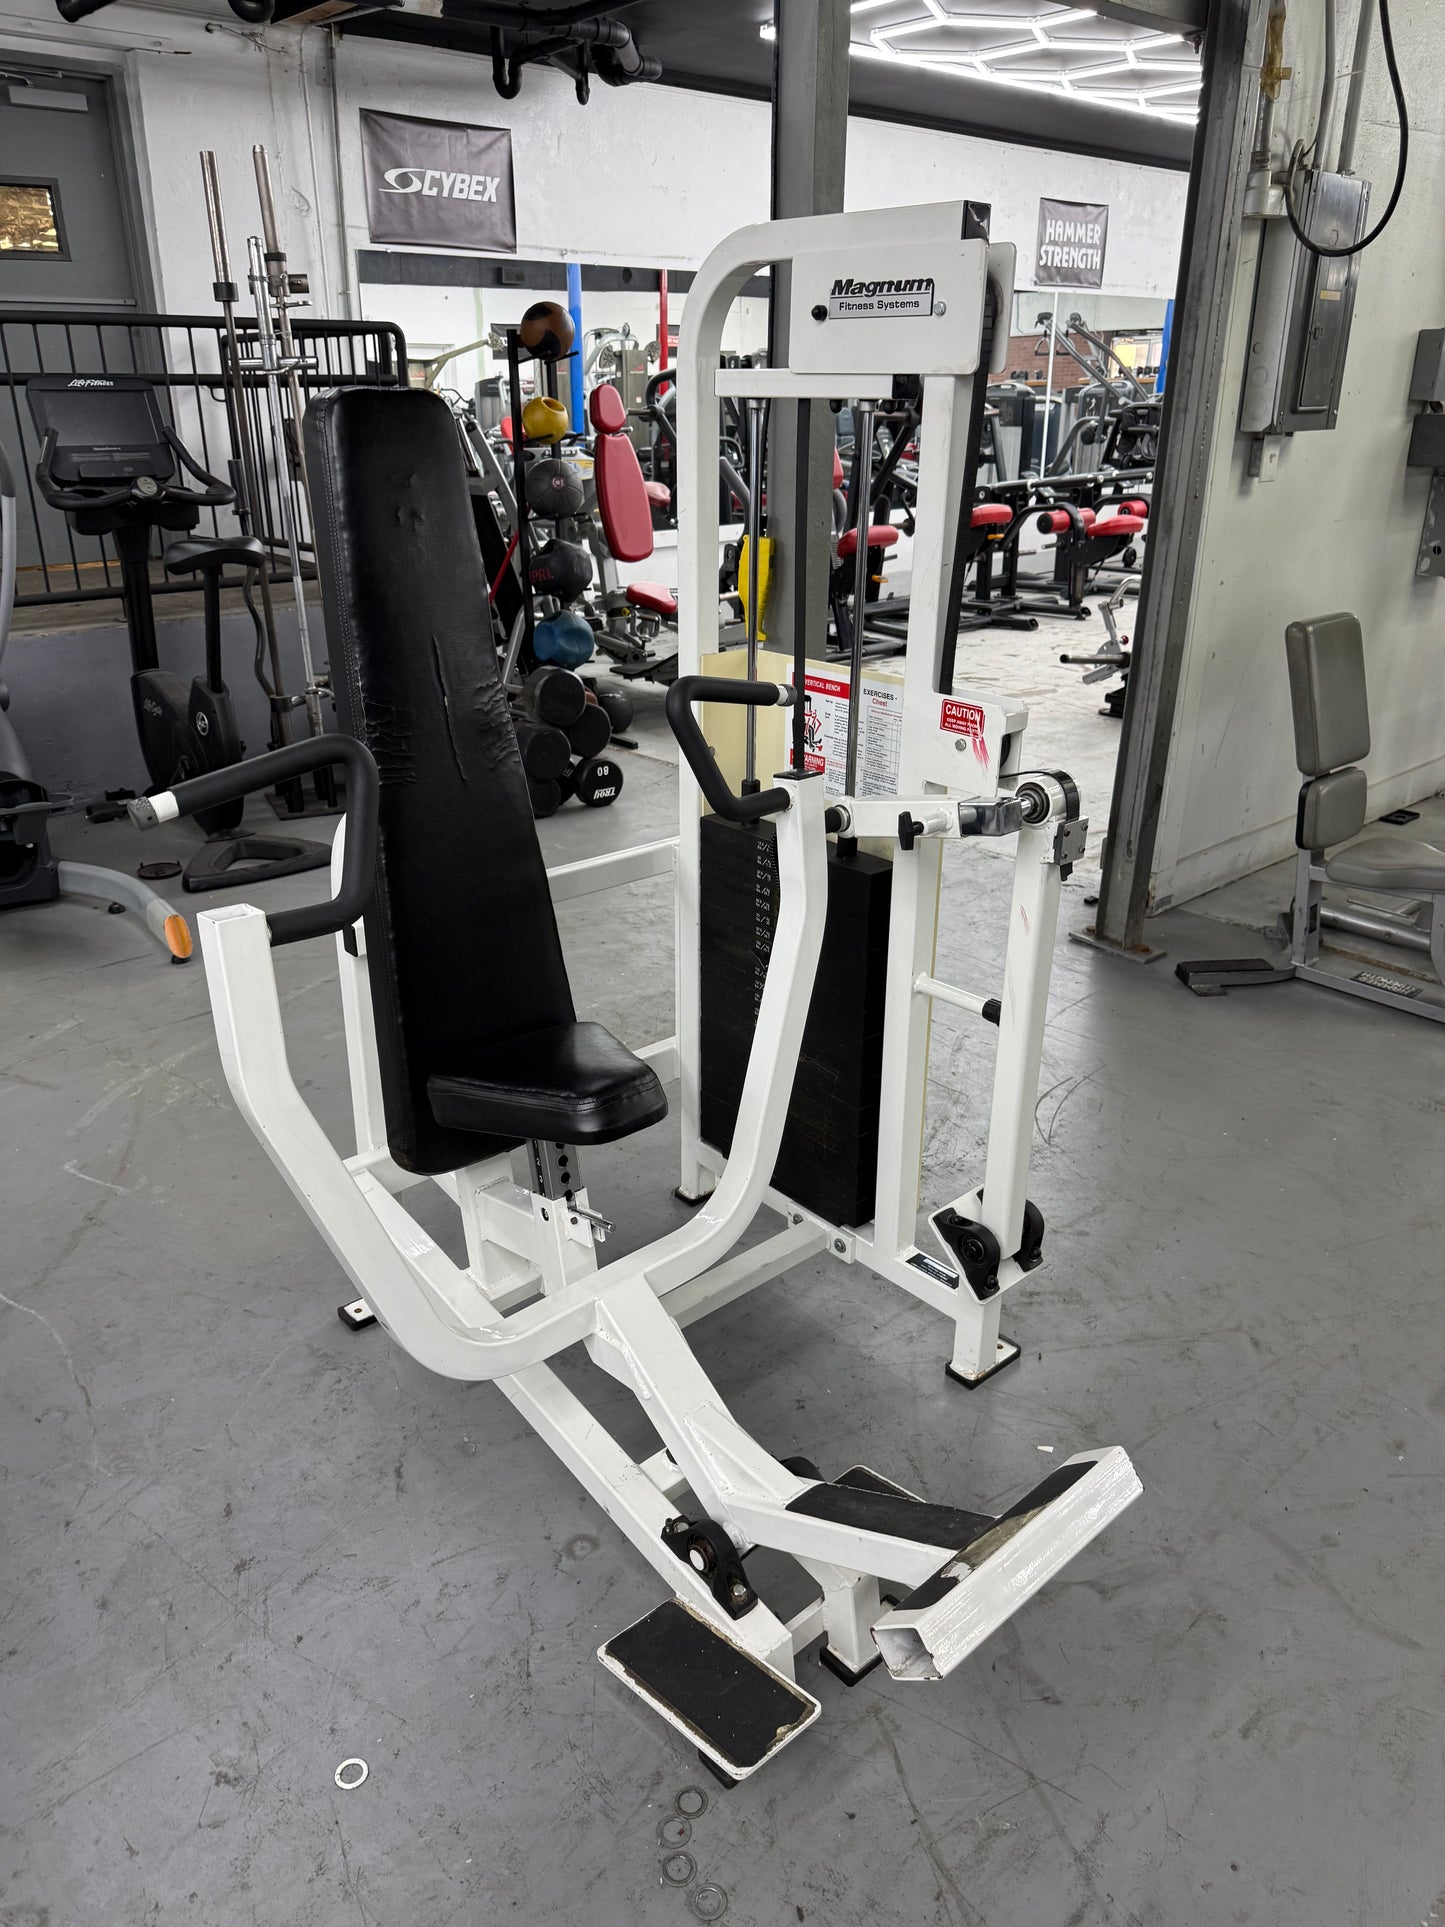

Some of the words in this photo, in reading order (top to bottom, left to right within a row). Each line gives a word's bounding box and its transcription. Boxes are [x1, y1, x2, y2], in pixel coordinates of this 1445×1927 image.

[421, 169, 500, 203] CYBEX
[1045, 219, 1101, 245] HAMMER
[1039, 244, 1101, 270] STRENGTH
[830, 278, 934, 298] Magnum
[839, 302, 874, 312] Fitness
[877, 300, 920, 311] Systems
[863, 688, 895, 701] EXERCISES
[872, 697, 888, 707] Chest
[945, 704, 982, 721] CAUTION
[597, 765, 610, 777] 80
[593, 786, 616, 800] TROY
